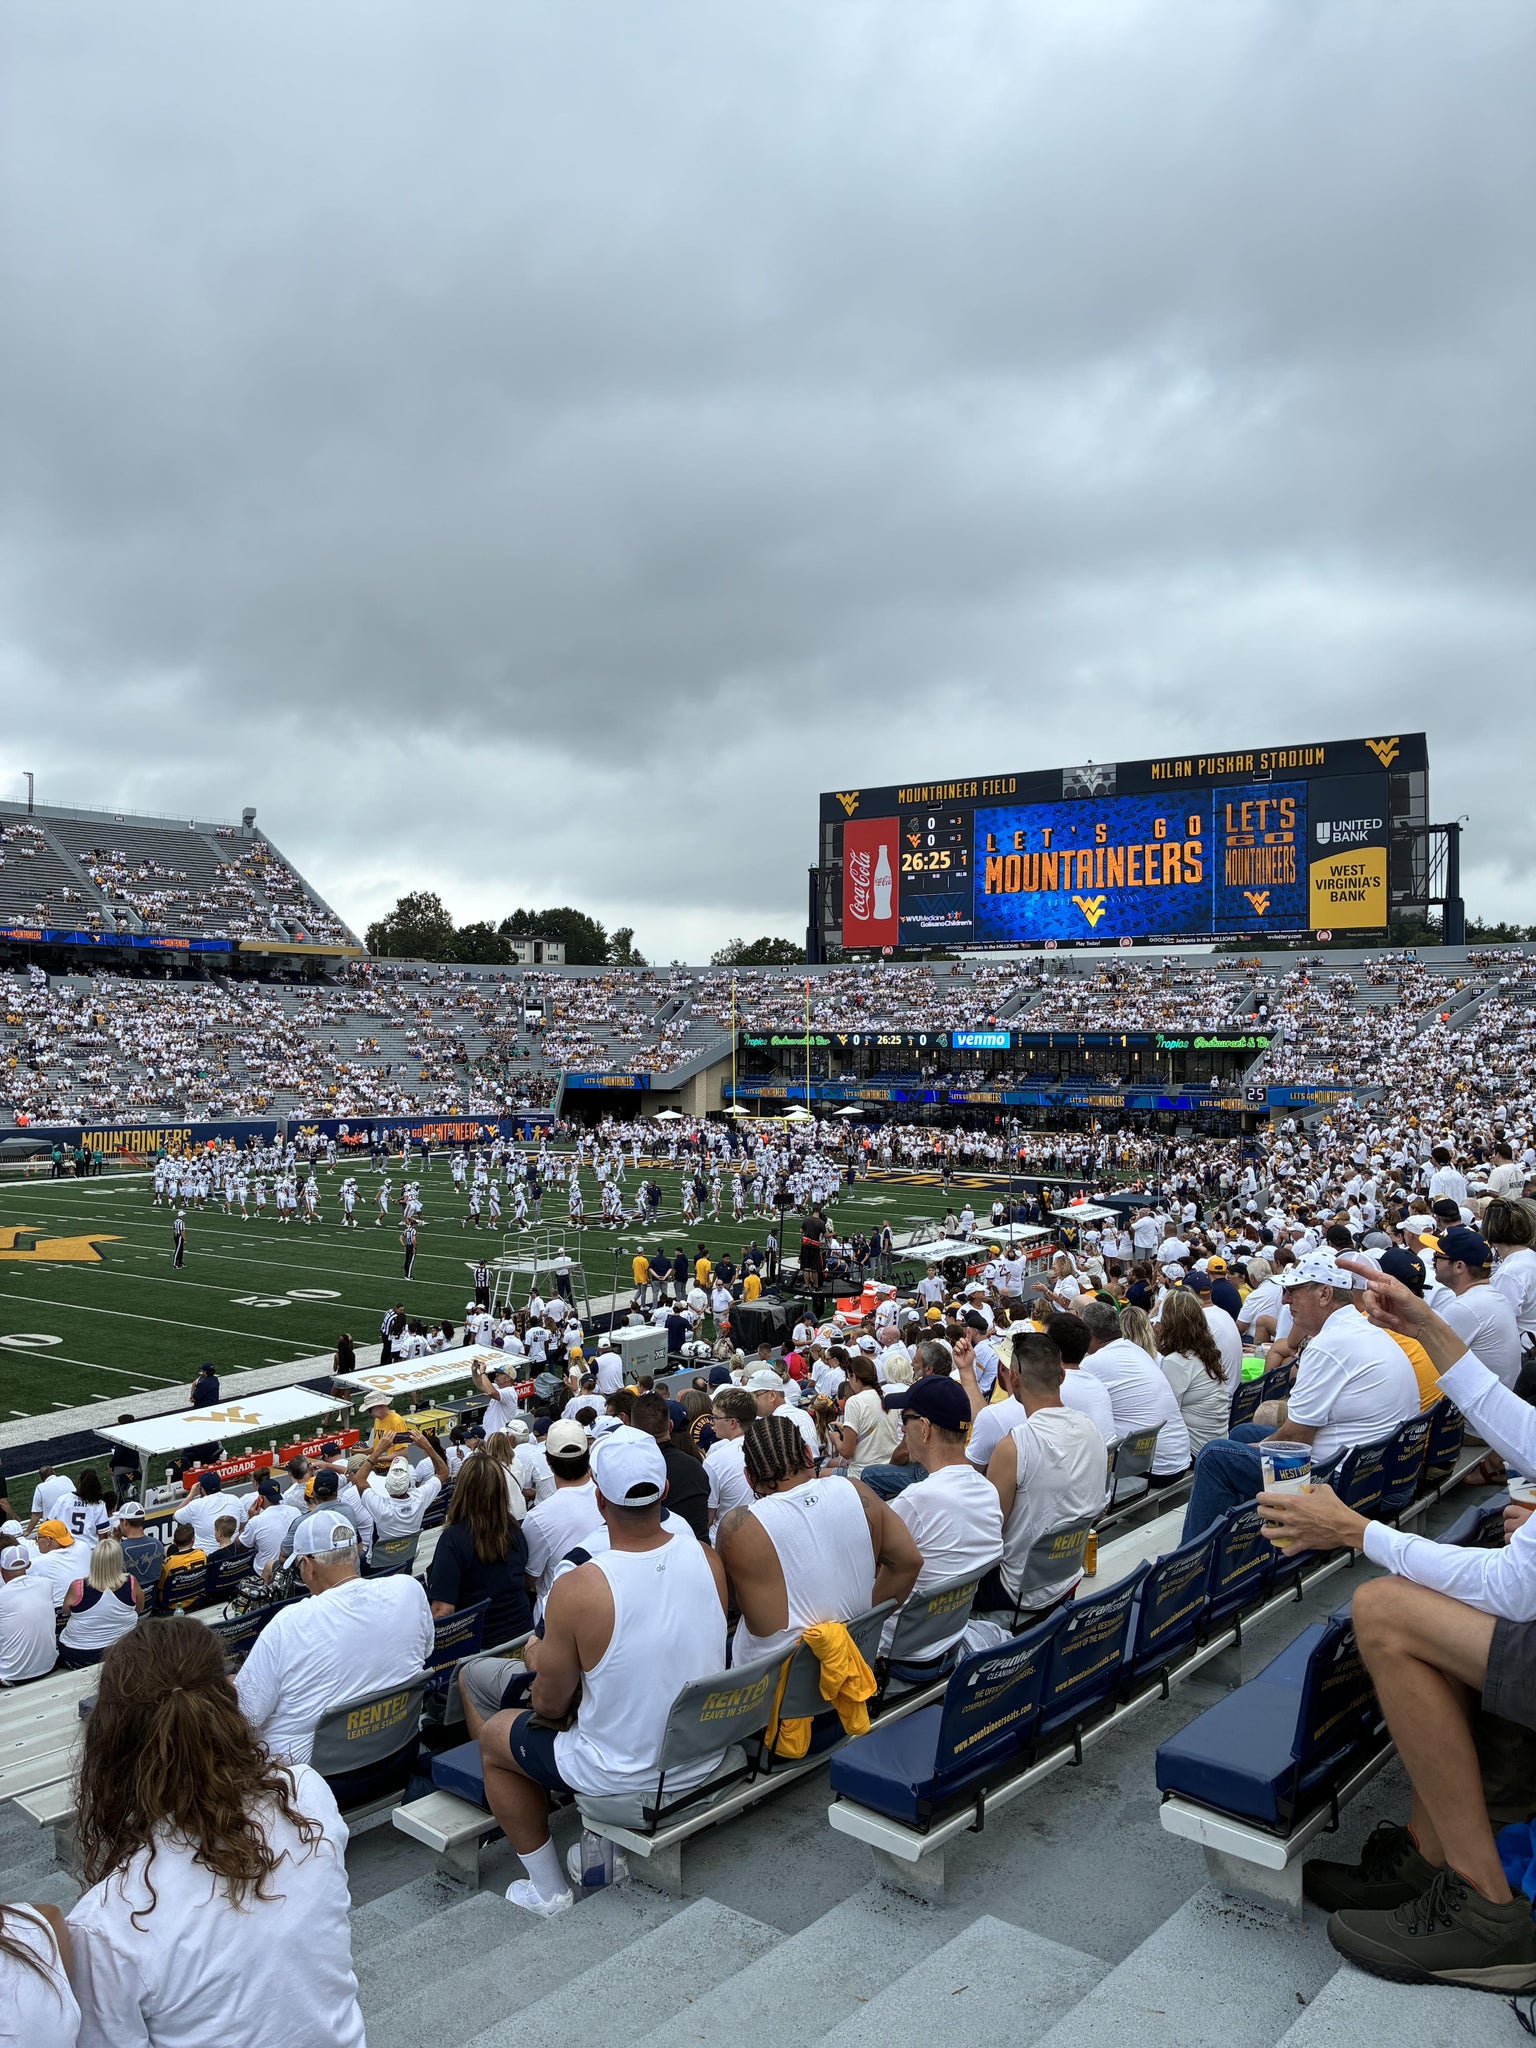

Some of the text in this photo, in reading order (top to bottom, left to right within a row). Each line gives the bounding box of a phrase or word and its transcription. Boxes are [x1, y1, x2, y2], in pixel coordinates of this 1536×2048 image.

[1151, 747, 1325, 780] MILAN PUSKAR STADIUM
[898, 778, 1016, 804] MOUNTAINEER FIELD
[1226, 798, 1296, 832] LET'S
[928, 817, 936, 830] 0
[1154, 815, 1201, 839] GO
[1332, 818, 1382, 831] UNITED
[928, 834, 936, 846] 0
[1226, 832, 1294, 846] GO
[1332, 830, 1368, 843] BANK
[901, 850, 951, 872] 26:25
[984, 840, 1203, 894] MOUNTAINEERS
[1225, 845, 1296, 886] MOUNTAINEERS
[1330, 864, 1366, 876] WEST
[1316, 876, 1380, 890] VIRGINIA'S
[1330, 890, 1366, 902] BANK
[853, 1035, 860, 1046] 0
[877, 1035, 902, 1045] 26:25
[919, 1035, 927, 1046] 0
[958, 1034, 1005, 1046] venmo
[1155, 1034, 1255, 1050] Tropics Restaurant &
[1089, 1095, 1125, 1107] MOUNTAINEERS
[1248, 1088, 1264, 1100] 25
[81, 1128, 192, 1152] MOUNTAINEERS
[478, 1273, 485, 1281] S
[484, 1321, 488, 1331] 5
[415, 1345, 420, 1356] 5
[216, 1460, 256, 1478] ATORADE
[1279, 1467, 1298, 1480] WEST
[71, 1512, 86, 1534] 5
[1052, 1530, 1086, 1551] RENT
[702, 1674, 770, 1710] RENTED
[346, 1692, 410, 1730] RENTED
[700, 1708, 725, 1723] LEAVE
[347, 1727, 370, 1740] LEAVE
[371, 1724, 380, 1732] IN
[954, 1703, 1032, 1755] www.mountaineerseats.com
